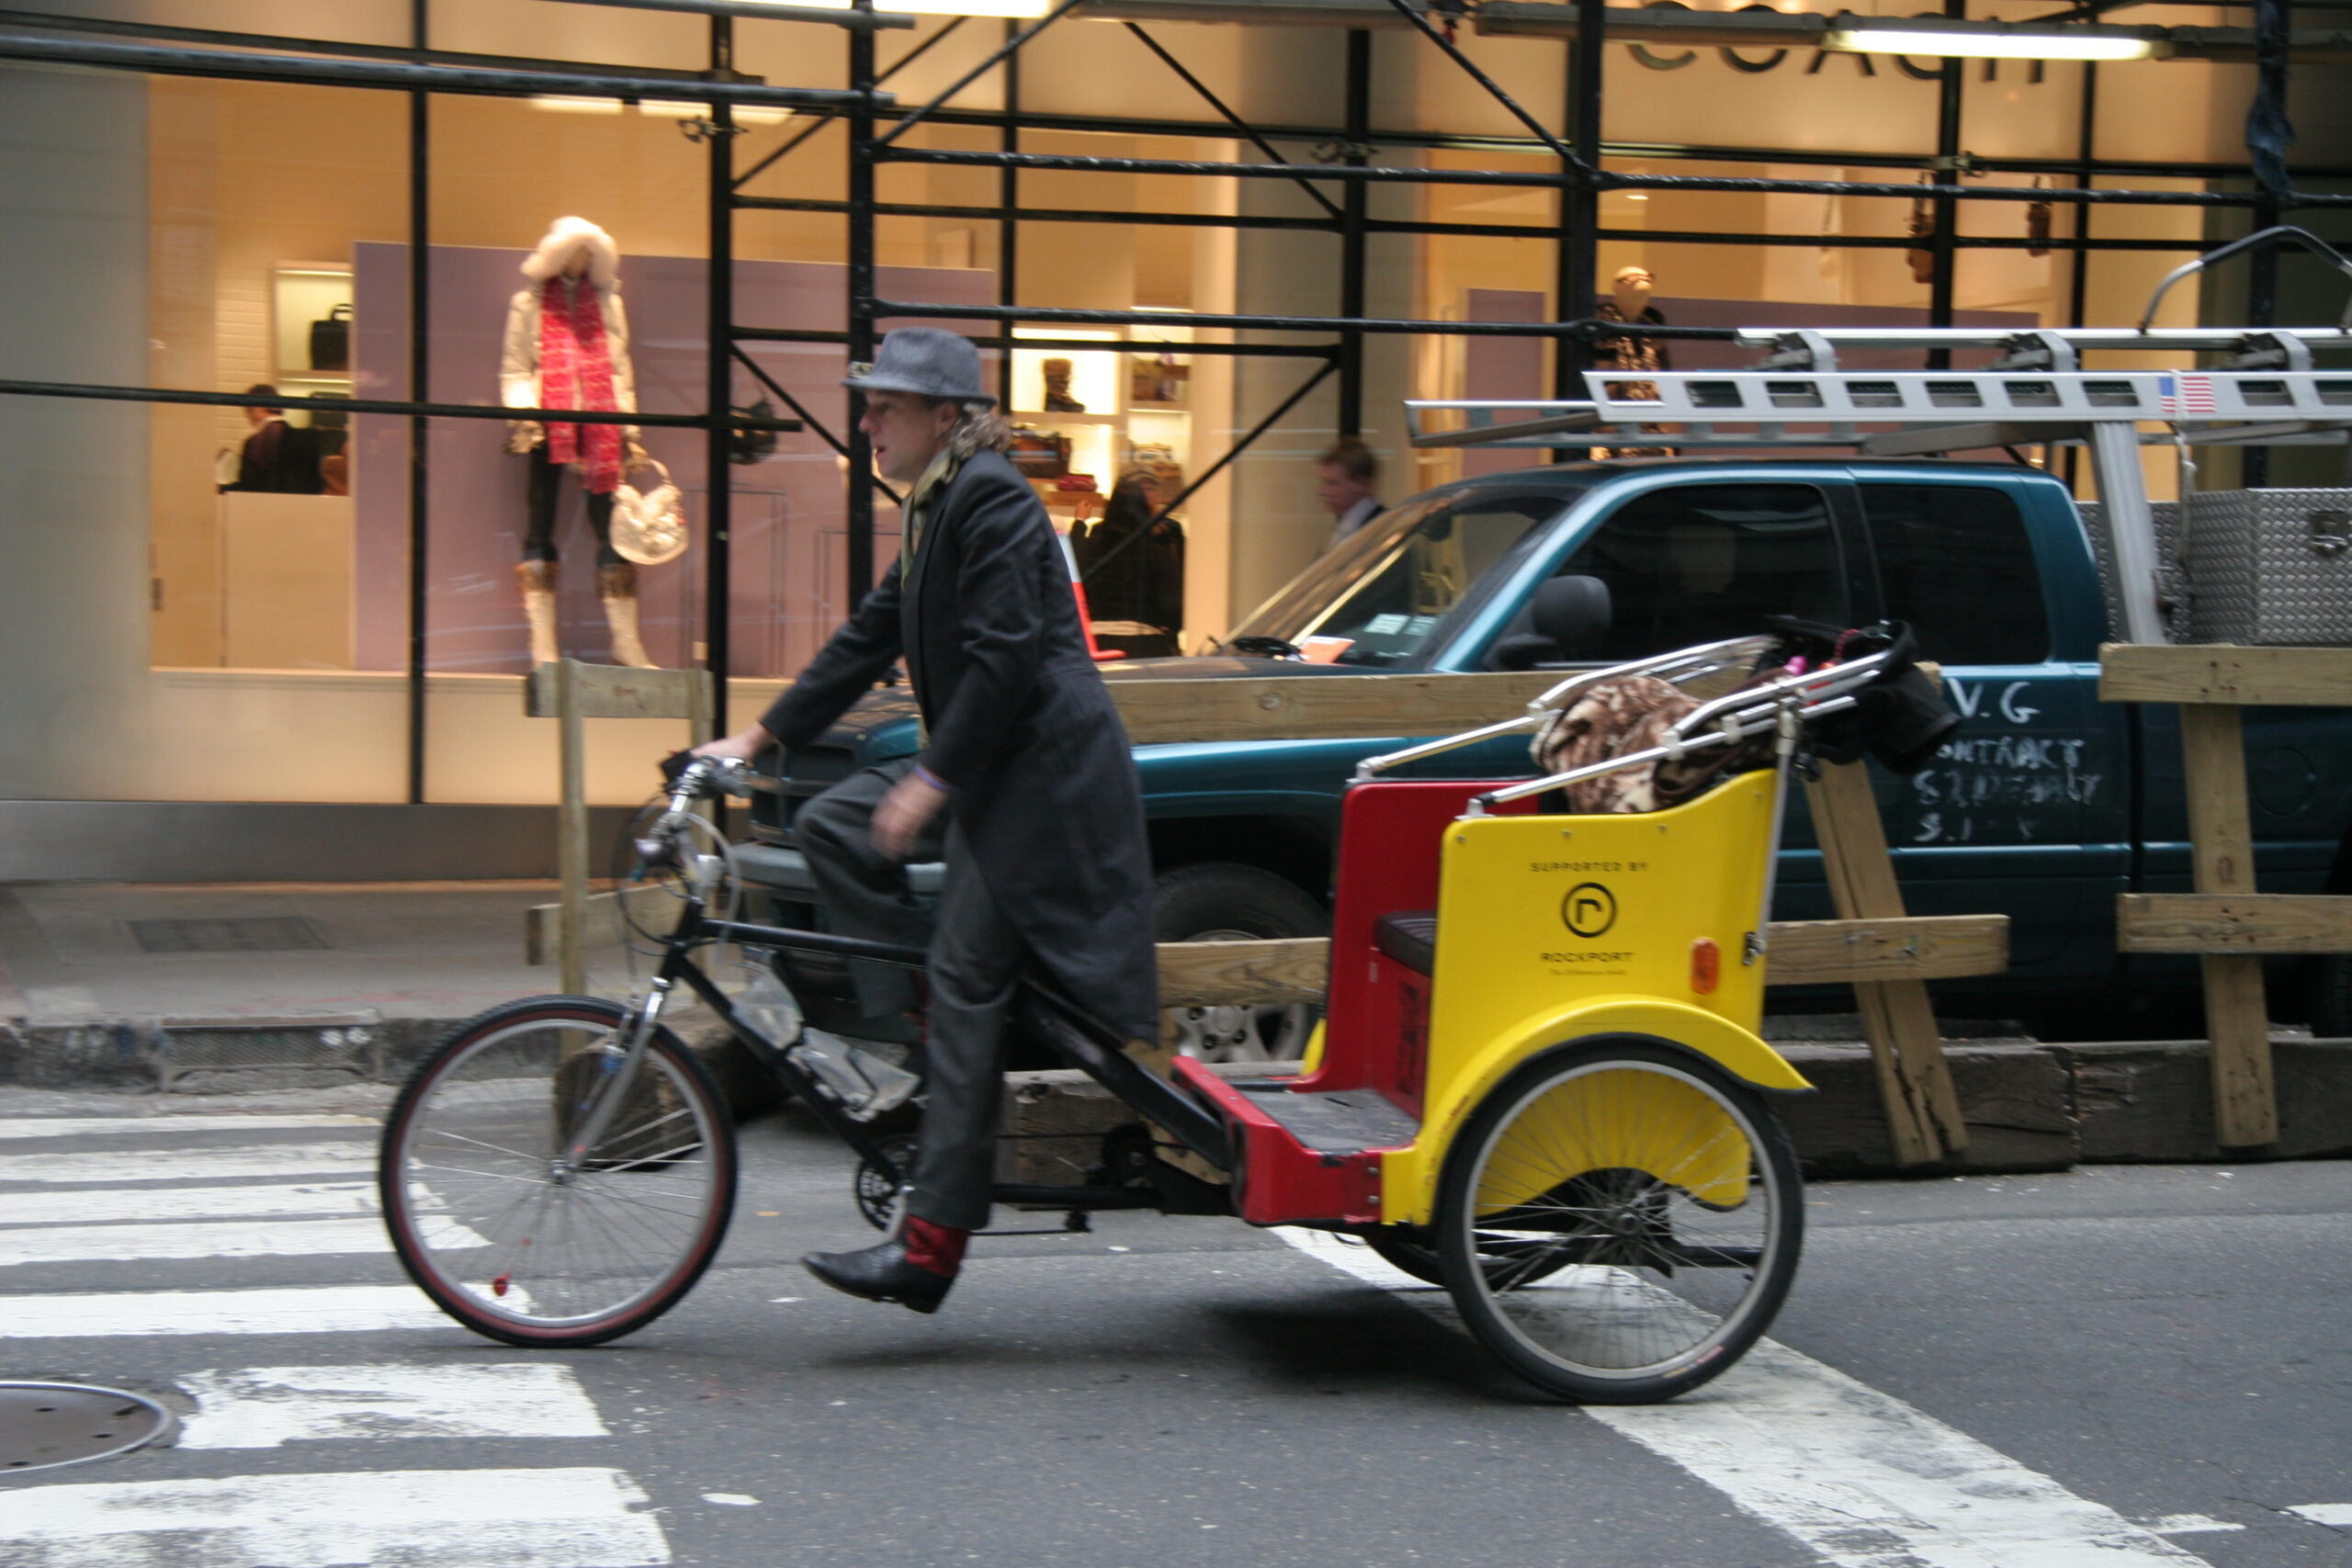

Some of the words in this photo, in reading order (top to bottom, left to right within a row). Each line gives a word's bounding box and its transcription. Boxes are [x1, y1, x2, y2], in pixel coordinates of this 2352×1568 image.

[1530, 862, 1622, 873] SUPPORTED
[1628, 862, 1649, 873] BY
[1539, 952, 1634, 963] ROCKPORT
